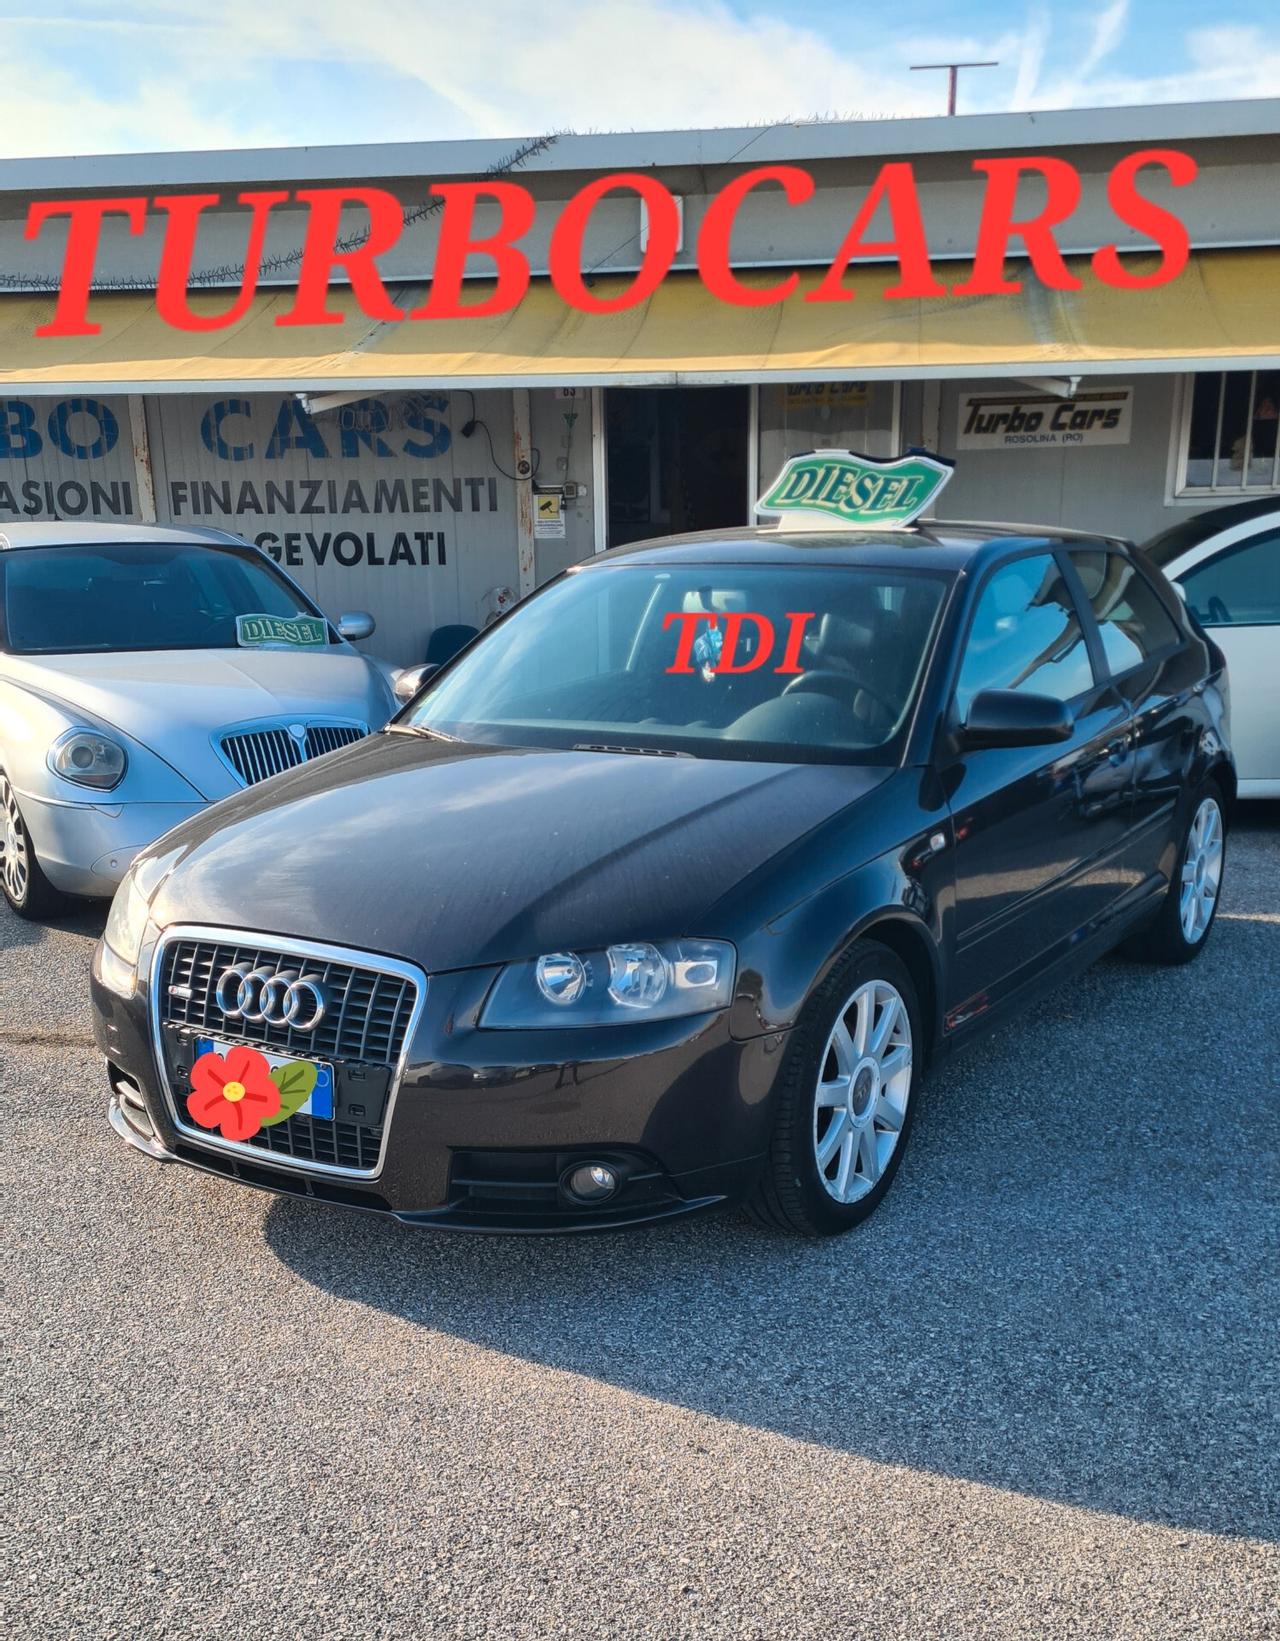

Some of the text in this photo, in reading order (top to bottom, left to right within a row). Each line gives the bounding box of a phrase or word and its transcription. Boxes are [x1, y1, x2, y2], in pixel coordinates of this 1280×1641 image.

[201, 398, 451, 461] CARS
[963, 398, 1122, 435] Turbo Cars
[1004, 433, 1083, 444] ROSOLINA (RO)
[0, 480, 133, 516] ASIONI
[170, 477, 498, 516] FINANZIAMENTI
[774, 464, 924, 514] DIESEL
[238, 531, 447, 567] GEVOLATI
[244, 619, 322, 642] DIESEL
